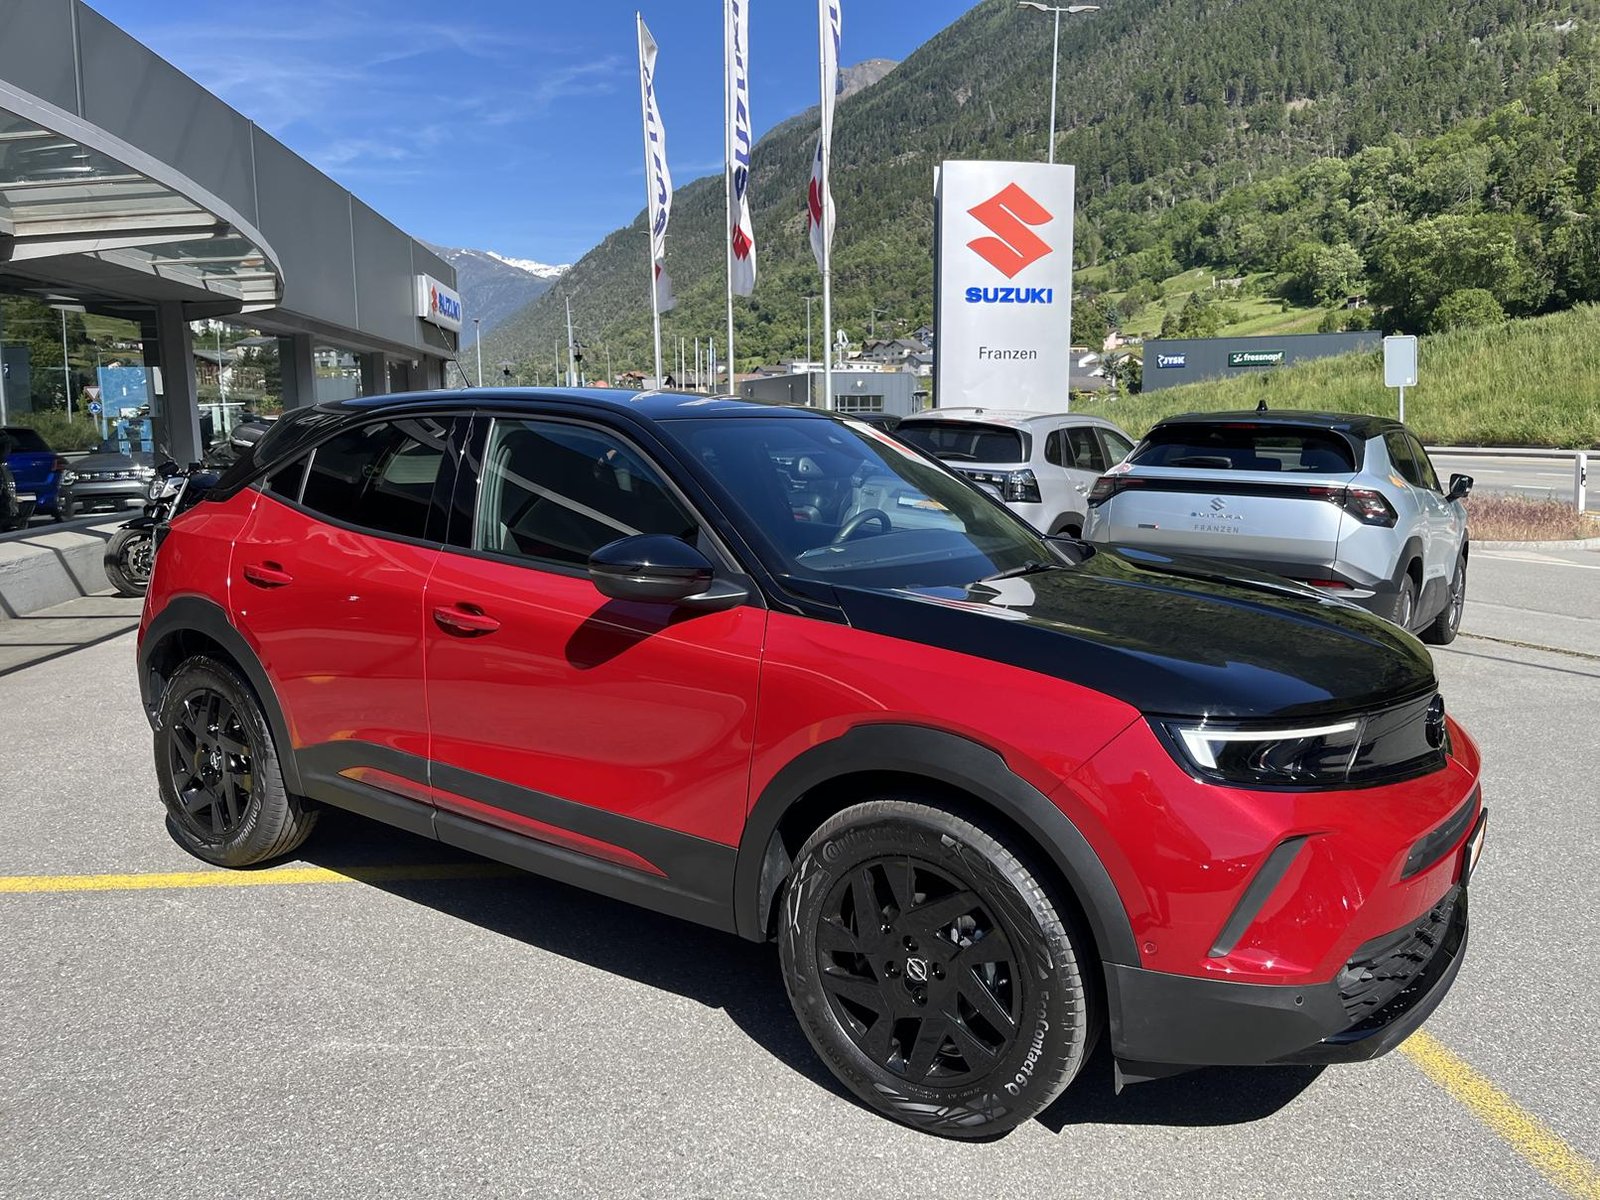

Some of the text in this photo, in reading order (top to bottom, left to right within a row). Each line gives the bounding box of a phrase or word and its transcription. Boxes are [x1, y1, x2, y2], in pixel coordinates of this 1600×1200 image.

[965, 287, 1053, 304] SUZUKI
[979, 346, 1037, 361] Franzen
[1163, 356, 1185, 365] JYSK
[1194, 524, 1239, 533] FRANZEN
